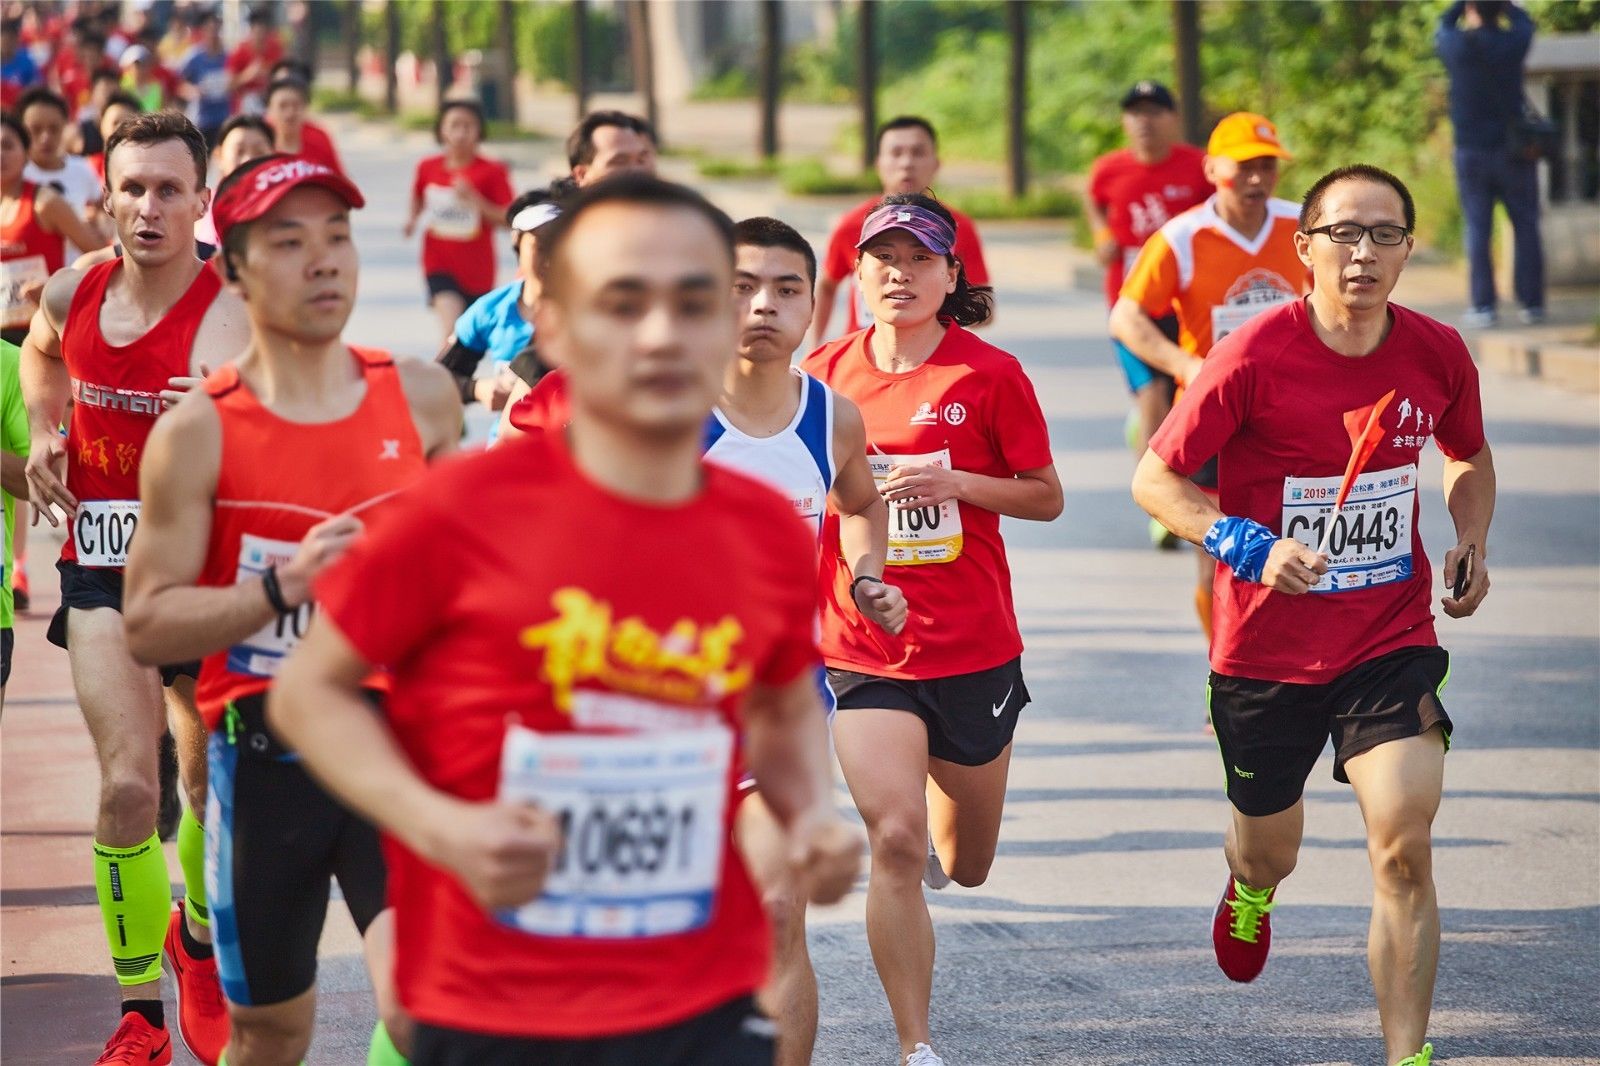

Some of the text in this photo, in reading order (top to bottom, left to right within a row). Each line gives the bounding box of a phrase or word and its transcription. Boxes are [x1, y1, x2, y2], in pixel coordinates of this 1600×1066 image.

[887, 496, 940, 531] 160
[1303, 488, 1326, 499] 2019
[78, 510, 138, 555] C102
[1287, 507, 1399, 556] C10443
